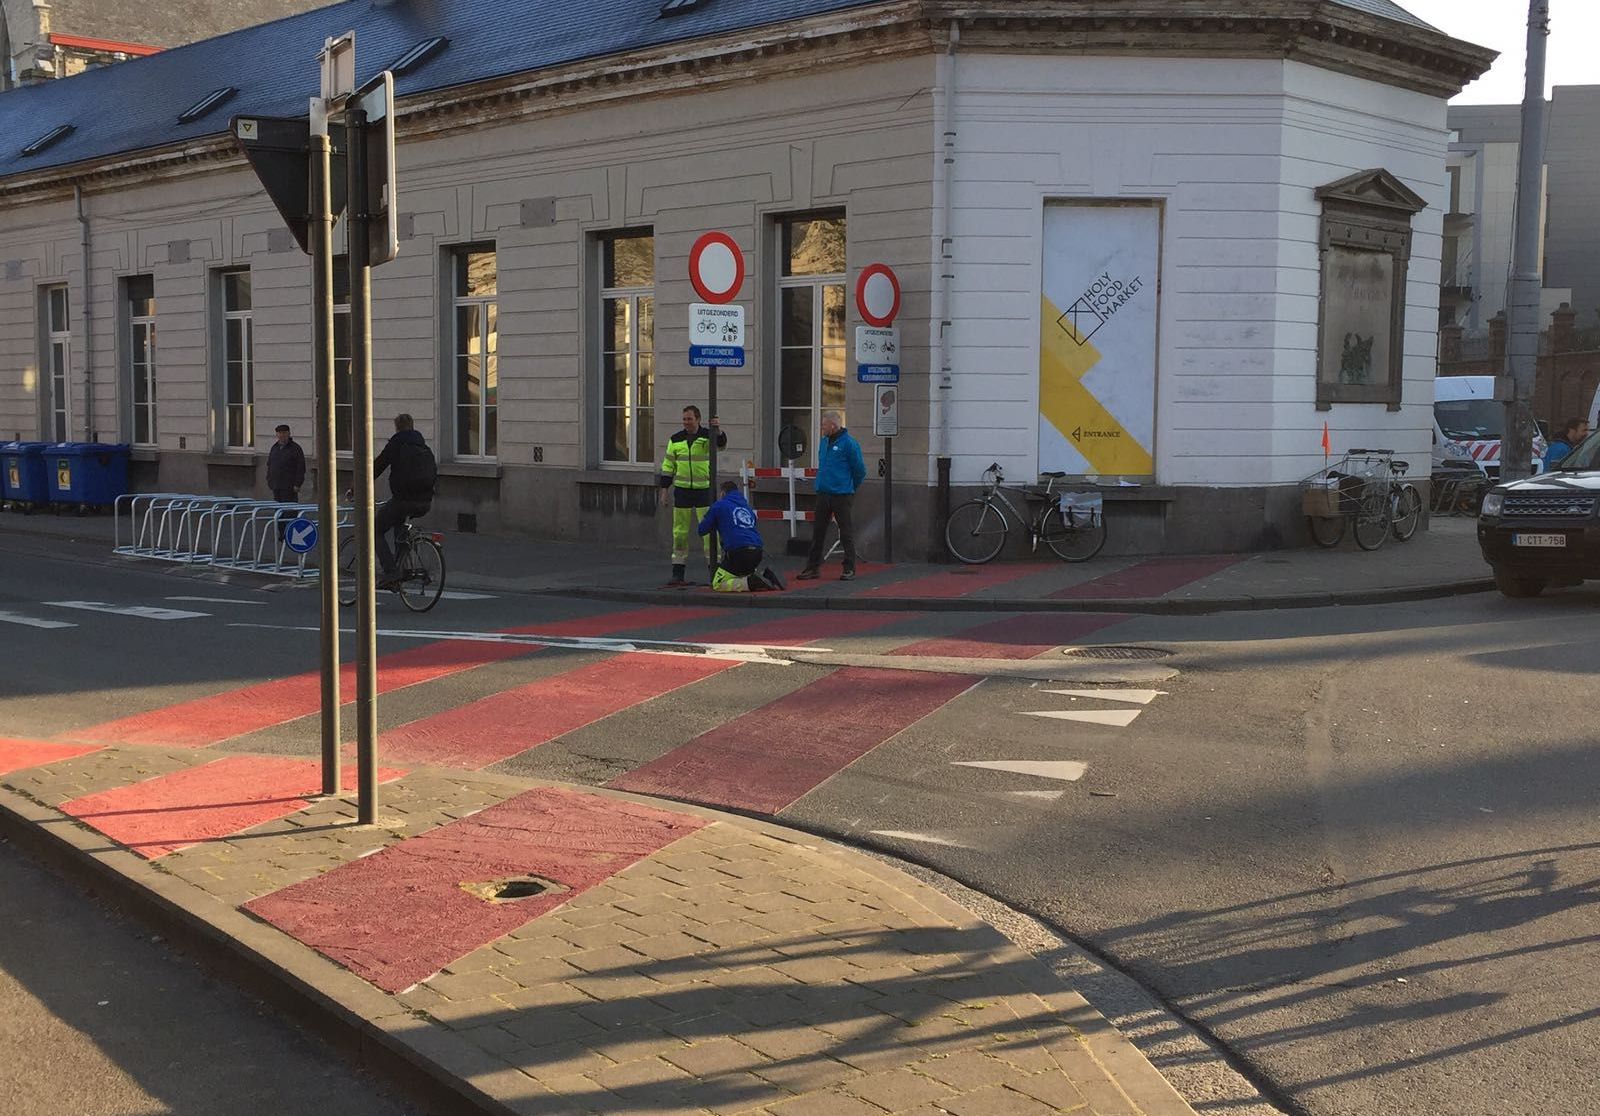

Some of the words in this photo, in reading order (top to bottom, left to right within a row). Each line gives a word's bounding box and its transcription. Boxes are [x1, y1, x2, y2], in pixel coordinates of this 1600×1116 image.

[1084, 272, 1111, 301] HOLY
[1092, 280, 1123, 311] FOOD
[1101, 276, 1143, 320] MARKET
[697, 309, 739, 317] UITGEZONDERD
[1518, 535, 1565, 545] 1-CTT-758
